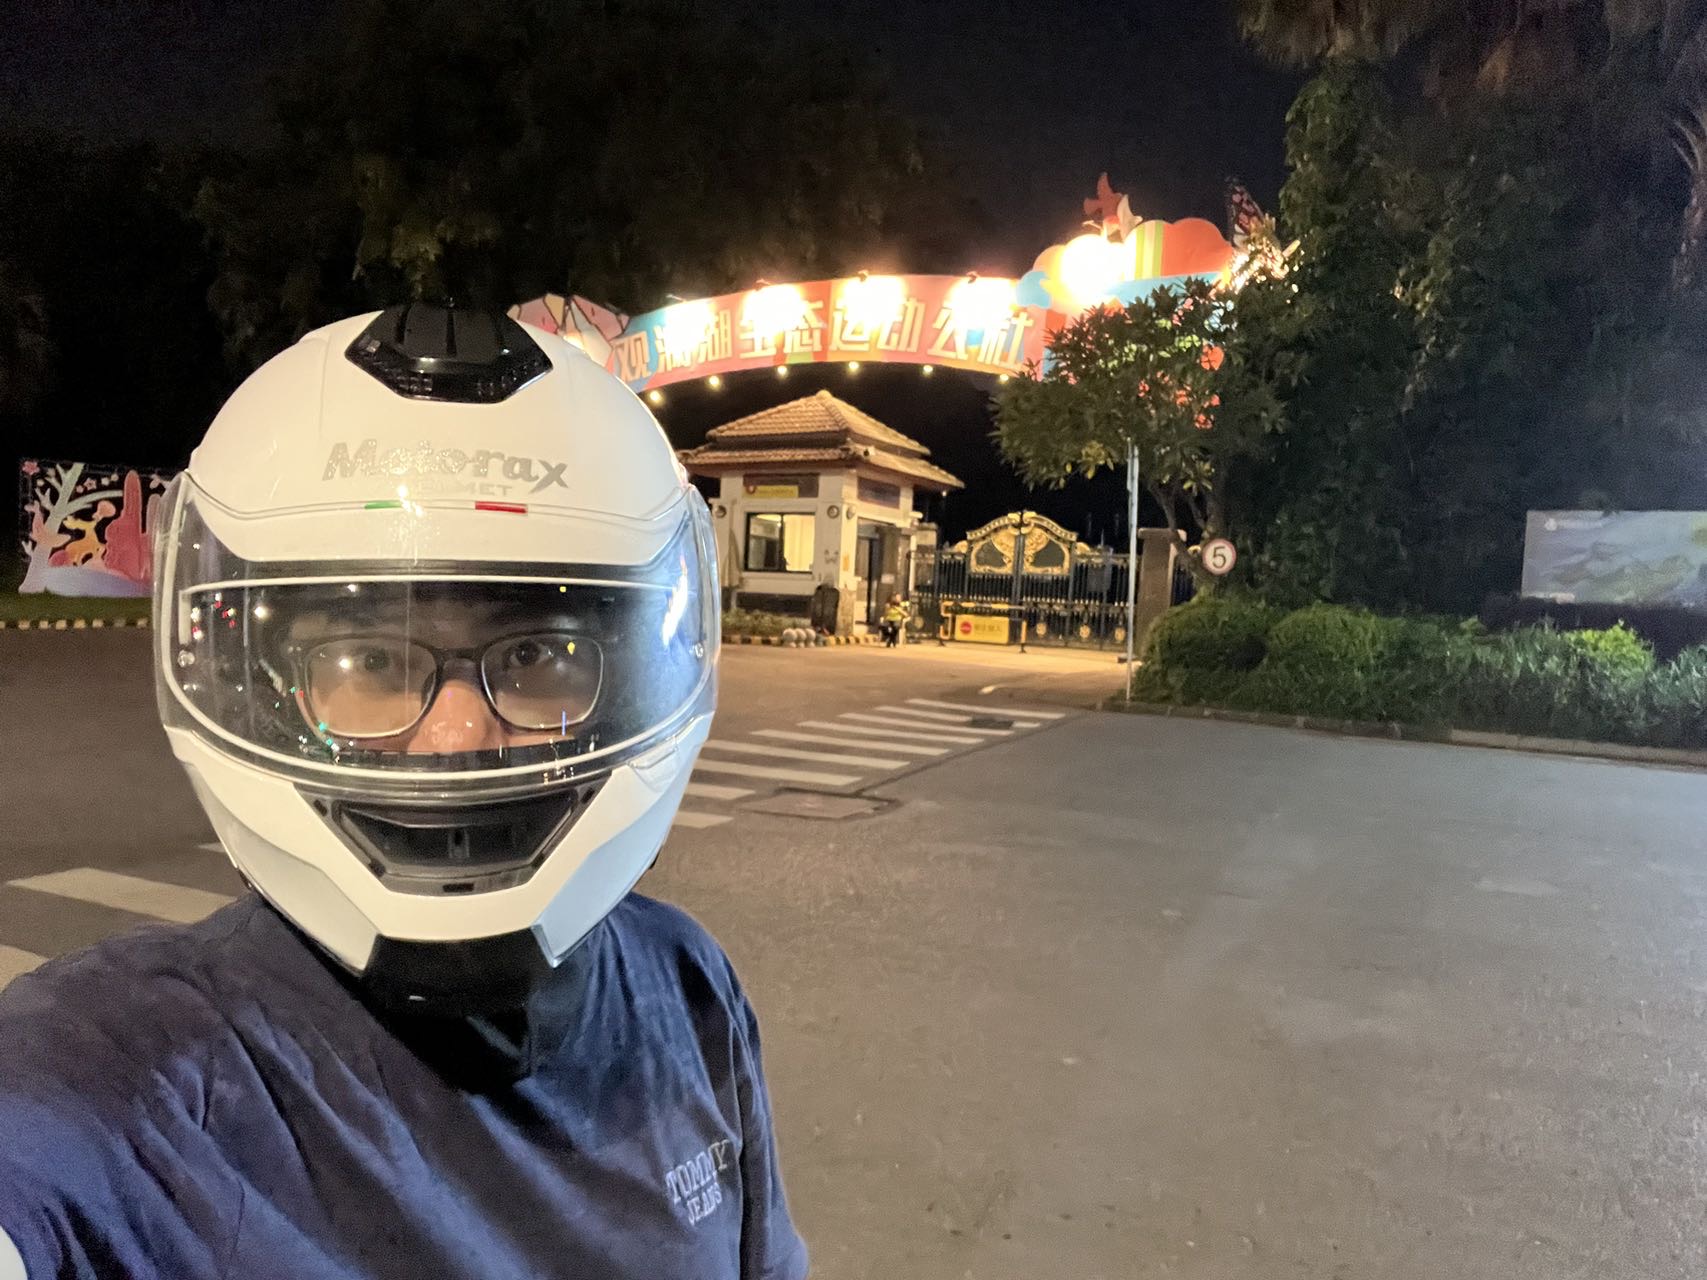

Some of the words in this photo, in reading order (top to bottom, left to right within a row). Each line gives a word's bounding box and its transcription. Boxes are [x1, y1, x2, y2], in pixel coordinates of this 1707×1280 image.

[322, 438, 568, 494] Motorax
[1212, 545, 1227, 569] 5
[665, 1139, 729, 1205] TOMMY
